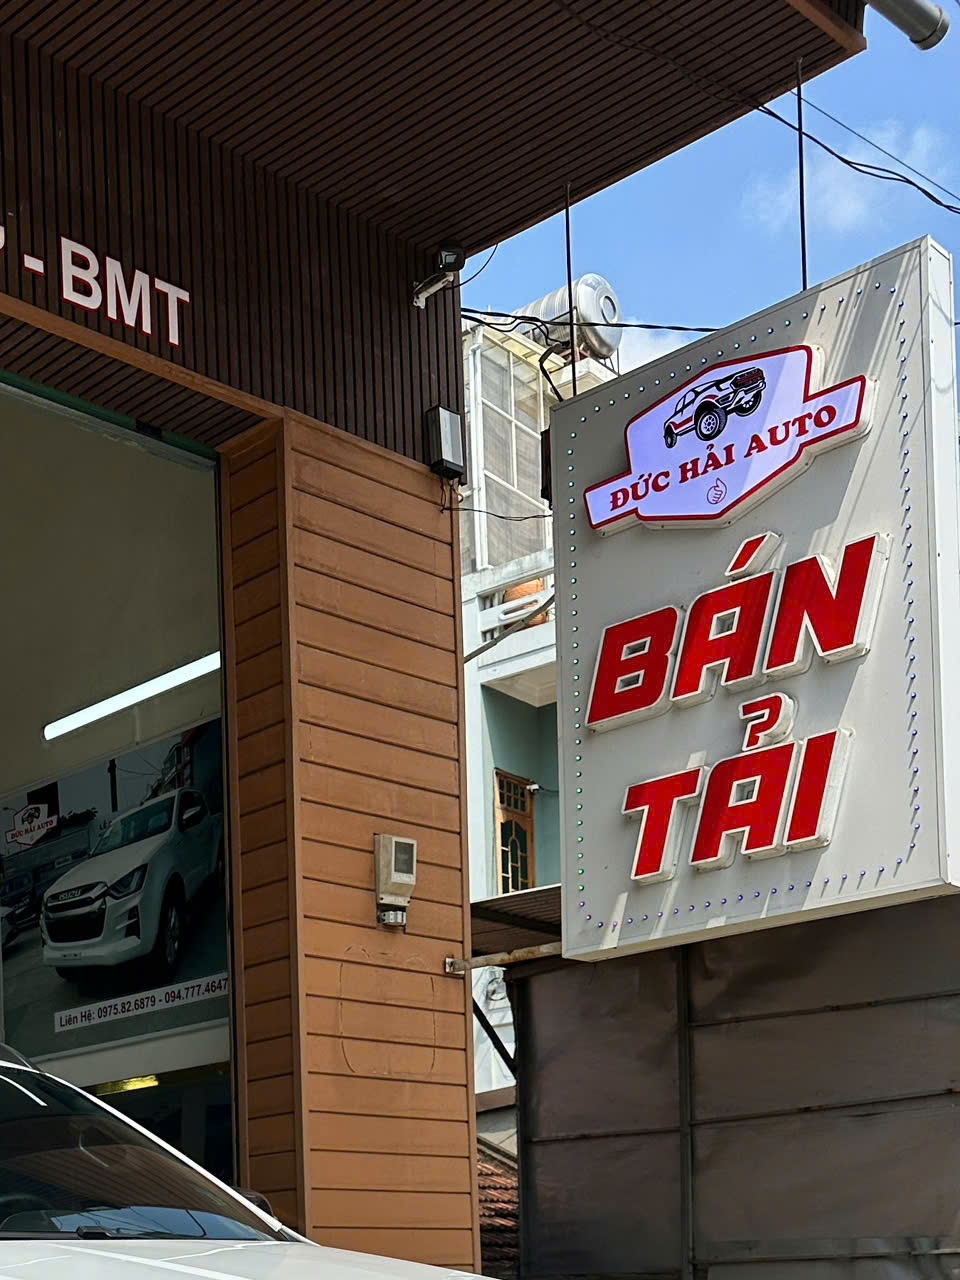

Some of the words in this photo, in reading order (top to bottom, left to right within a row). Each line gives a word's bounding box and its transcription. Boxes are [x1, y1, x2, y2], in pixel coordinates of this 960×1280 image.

[23, 253, 44, 275] -
[60, 236, 191, 348] BMT
[609, 471, 671, 511] ĐỨC
[678, 443, 736, 484] HẢI
[743, 404, 837, 458] AUTO
[585, 534, 882, 730] BÁN
[624, 694, 846, 882] TẢI
[59, 1013, 79, 1027] Liên
[81, 1010, 95, 1024] Hệ:
[97, 995, 156, 1019] 0975.82.6879
[164, 977, 229, 1004] 094.777.4647
